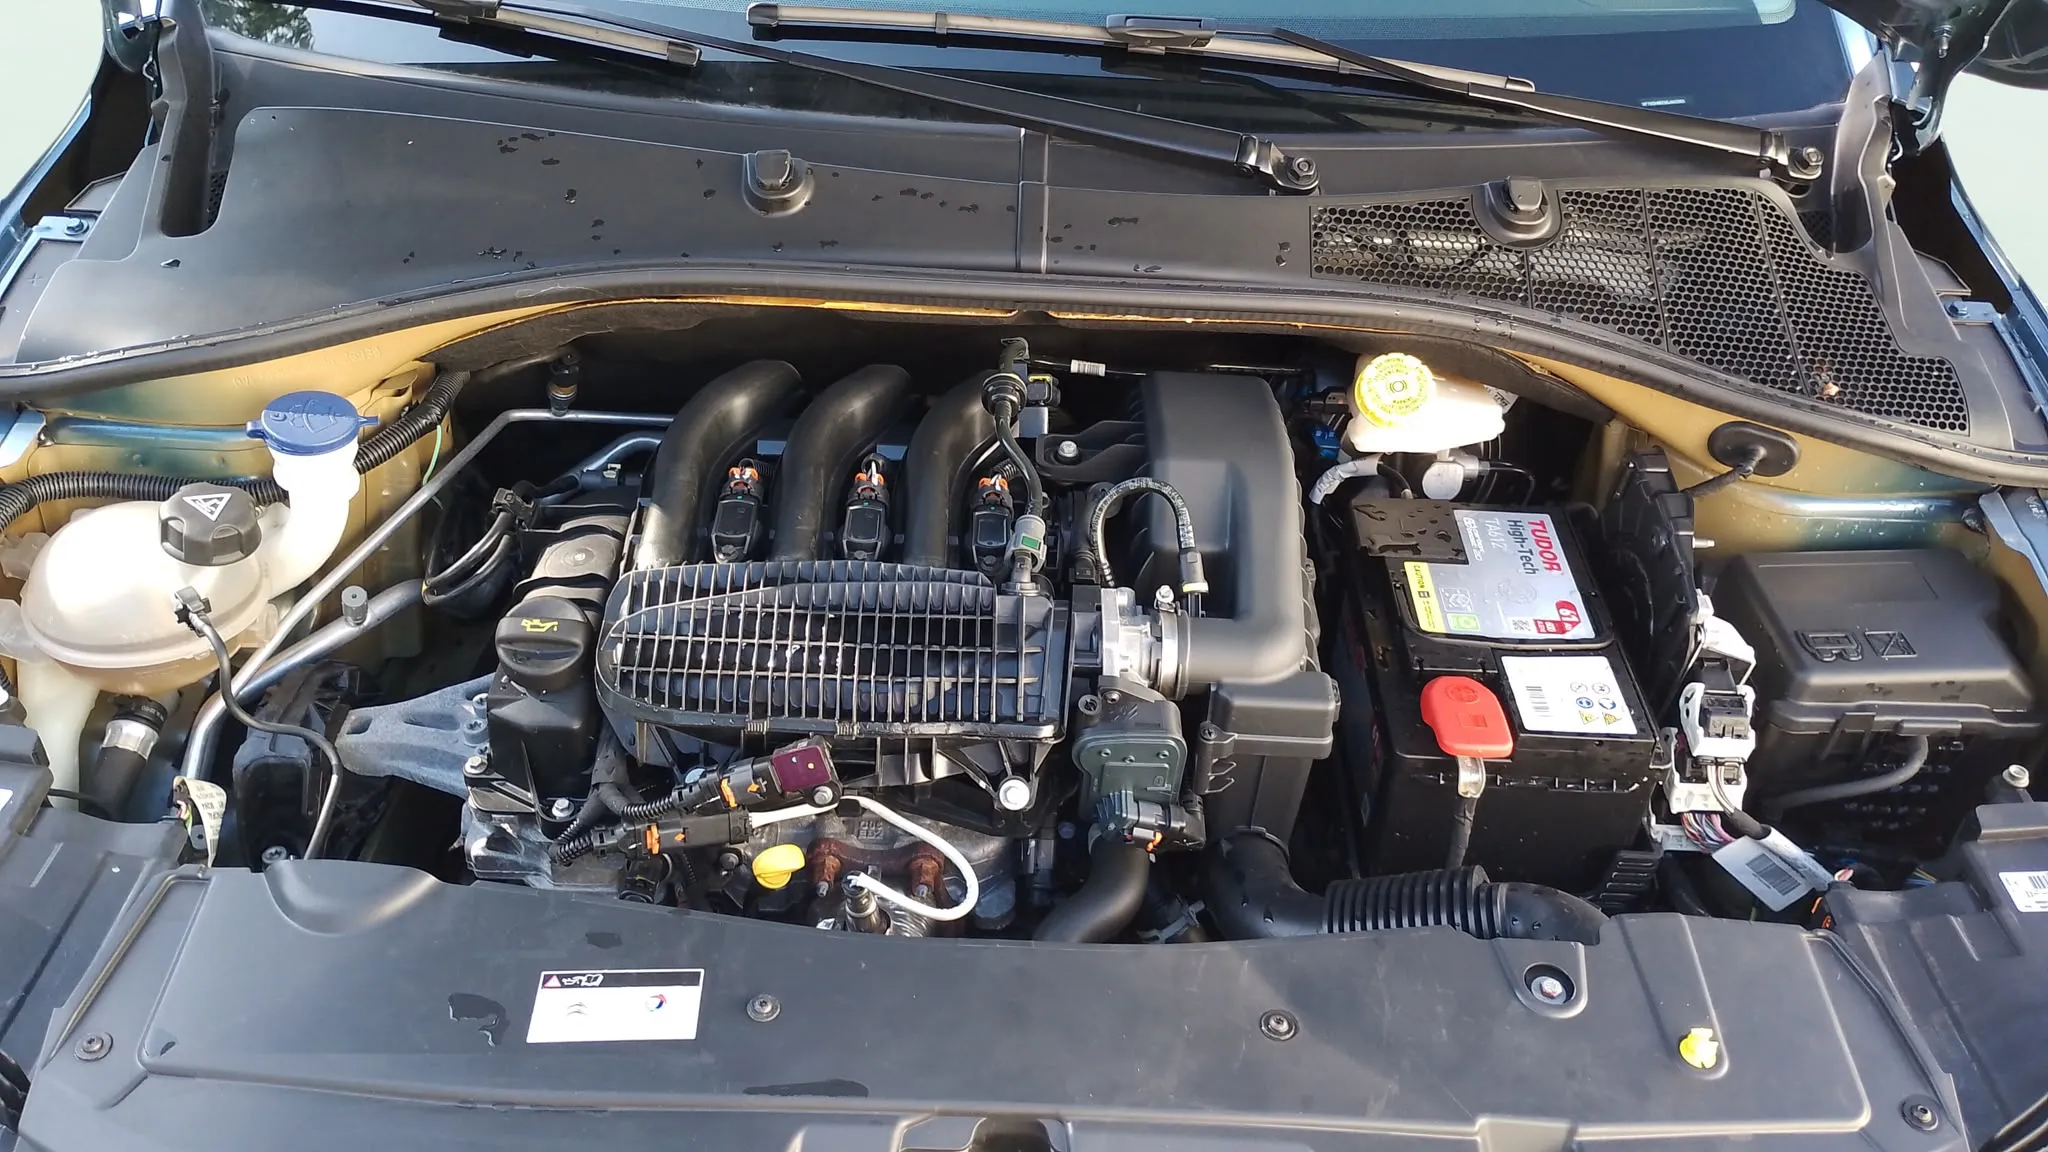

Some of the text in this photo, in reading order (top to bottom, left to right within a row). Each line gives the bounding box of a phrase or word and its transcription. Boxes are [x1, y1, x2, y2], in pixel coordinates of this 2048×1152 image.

[1484, 517, 1507, 550] TA612
[1507, 519, 1540, 575] High-Tech
[1527, 519, 1562, 572] TUDOR
[1413, 565, 1425, 588] CAUTION
[1558, 608, 1580, 621] 61
